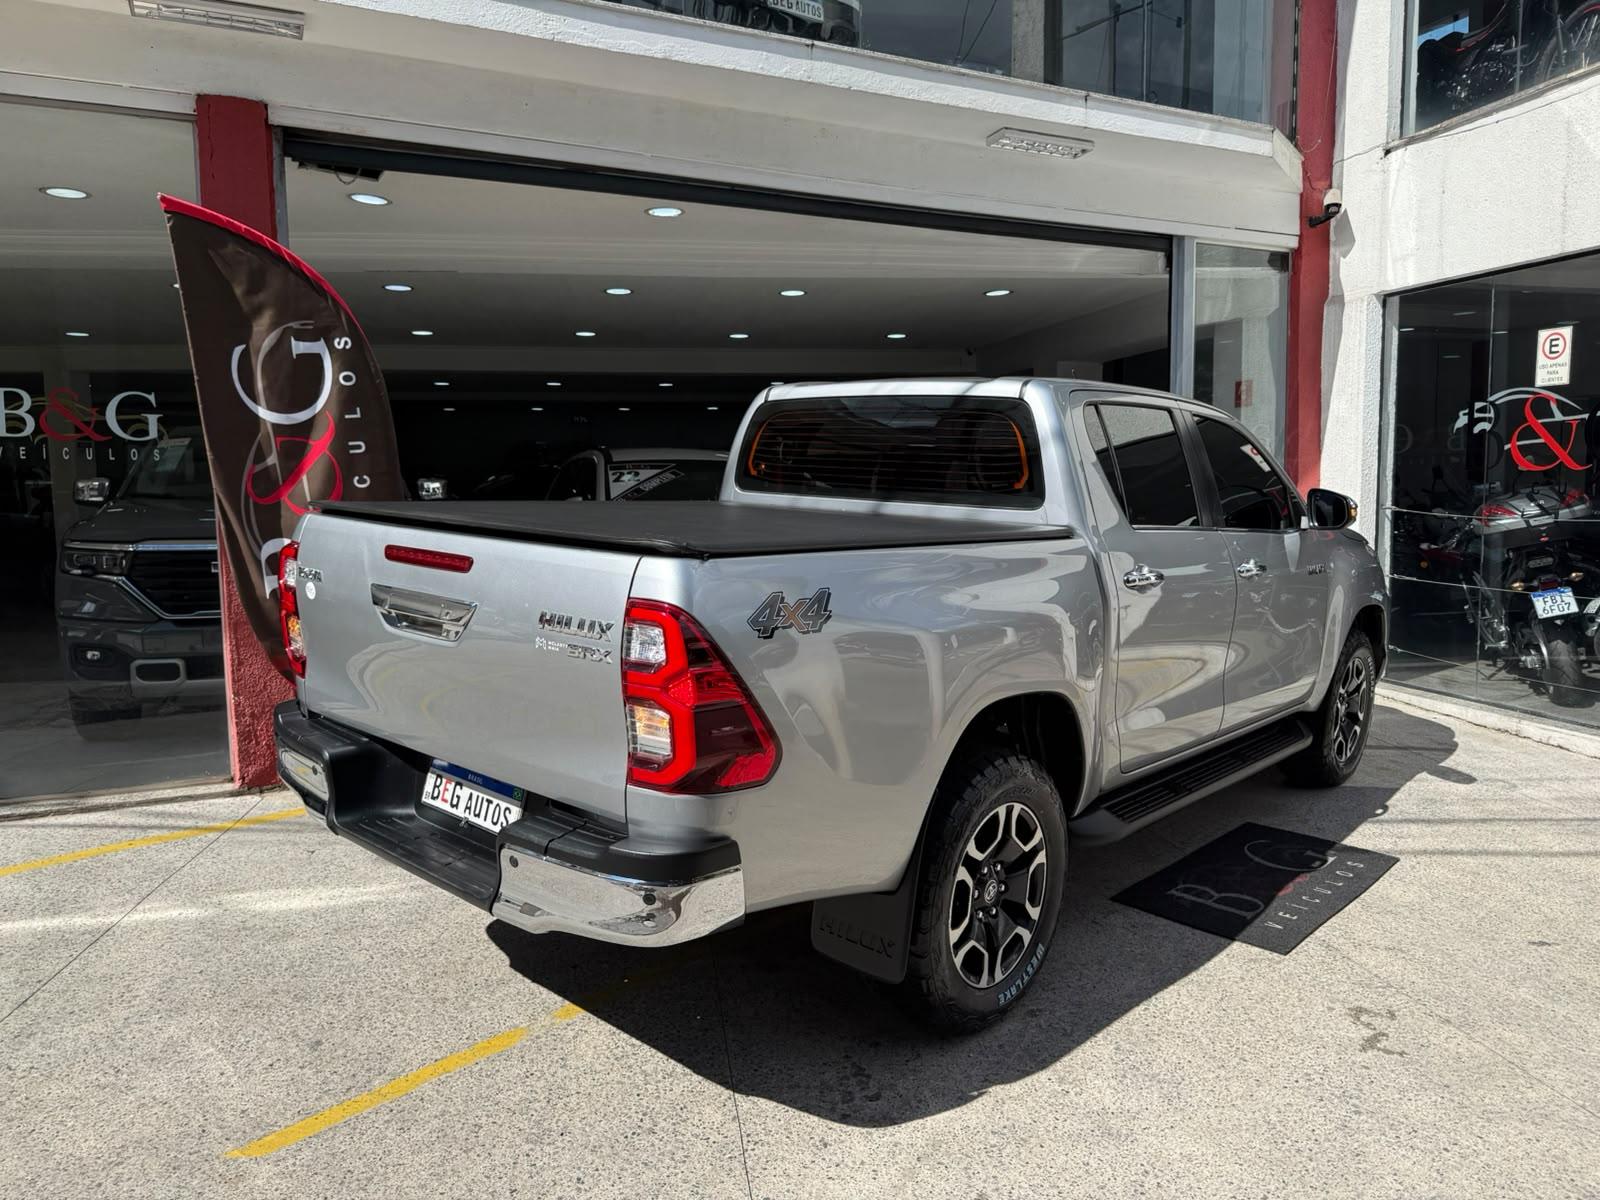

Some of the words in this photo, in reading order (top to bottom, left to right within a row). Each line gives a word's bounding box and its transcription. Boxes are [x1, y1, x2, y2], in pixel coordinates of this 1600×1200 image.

[795, 1, 822, 18] AUTOS
[1549, 338, 1560, 354] E
[0, 387, 163, 441] B&G
[538, 610, 614, 642] HILUX
[430, 773, 463, 810] BEG
[464, 791, 511, 828] AUTOS
[997, 943, 1046, 1004] WESTLAKE
